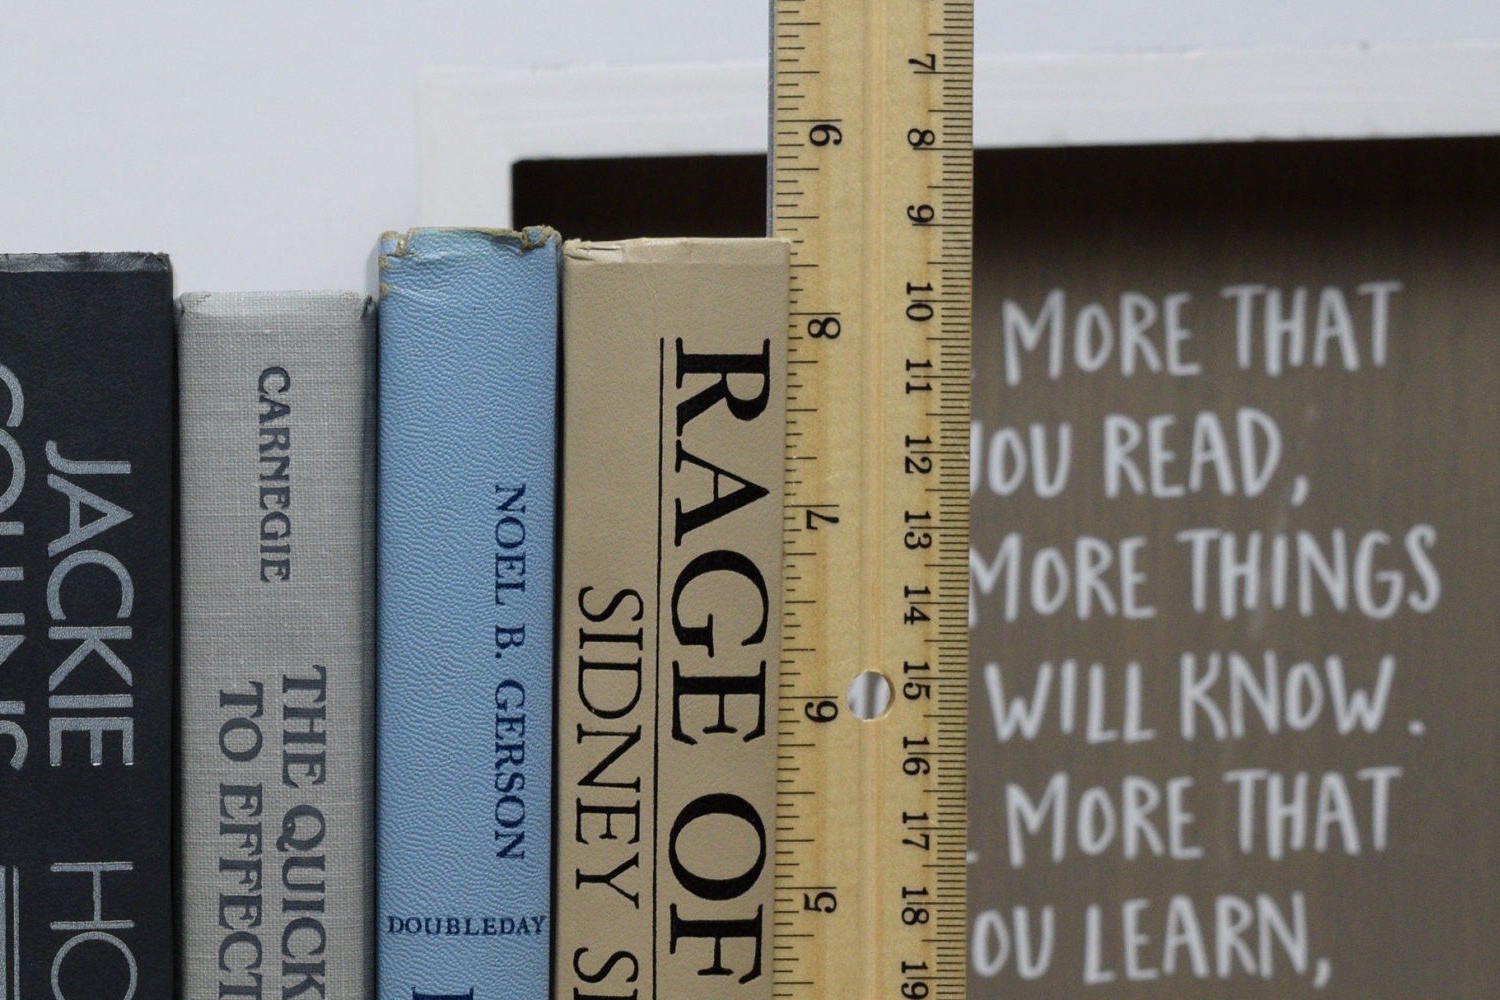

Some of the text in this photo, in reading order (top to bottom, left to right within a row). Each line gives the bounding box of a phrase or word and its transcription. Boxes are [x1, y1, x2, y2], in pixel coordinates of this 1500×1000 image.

[909, 53, 936, 72] 7
[809, 124, 842, 146] 9
[907, 129, 935, 147] 8
[907, 204, 935, 223] 9
[906, 282, 933, 322] 10
[808, 317, 841, 339] 8
[1004, 280, 1403, 386] MORE THAT
[905, 358, 932, 395] 11
[257, 365, 292, 583] CARNEGIE
[905, 435, 932, 474] 12
[1104, 408, 1308, 505] READ,
[806, 509, 840, 531] 7
[904, 510, 932, 550] 13
[670, 337, 771, 746] RAGE
[968, 525, 1440, 629] MORE THINGS
[44, 439, 135, 767] JACKIE
[904, 585, 931, 625] 14
[494, 483, 527, 860] NOEL B. GERSON
[903, 661, 931, 700] 15
[805, 700, 838, 723] 6
[984, 651, 1423, 744] WILL KNOW.
[218, 680, 264, 763] TO
[281, 664, 328, 786] THE
[575, 585, 644, 910] SIDNEY
[903, 736, 930, 775] 16
[902, 812, 930, 851] 17
[1006, 767, 1400, 867] MORE THAT
[668, 792, 767, 985] OF
[804, 891, 837, 913] 5
[902, 887, 929, 926] 18
[387, 914, 547, 937] DOUBLEDAY
[972, 893, 1331, 987] OU LEARN,
[901, 961, 929, 1000] 19
